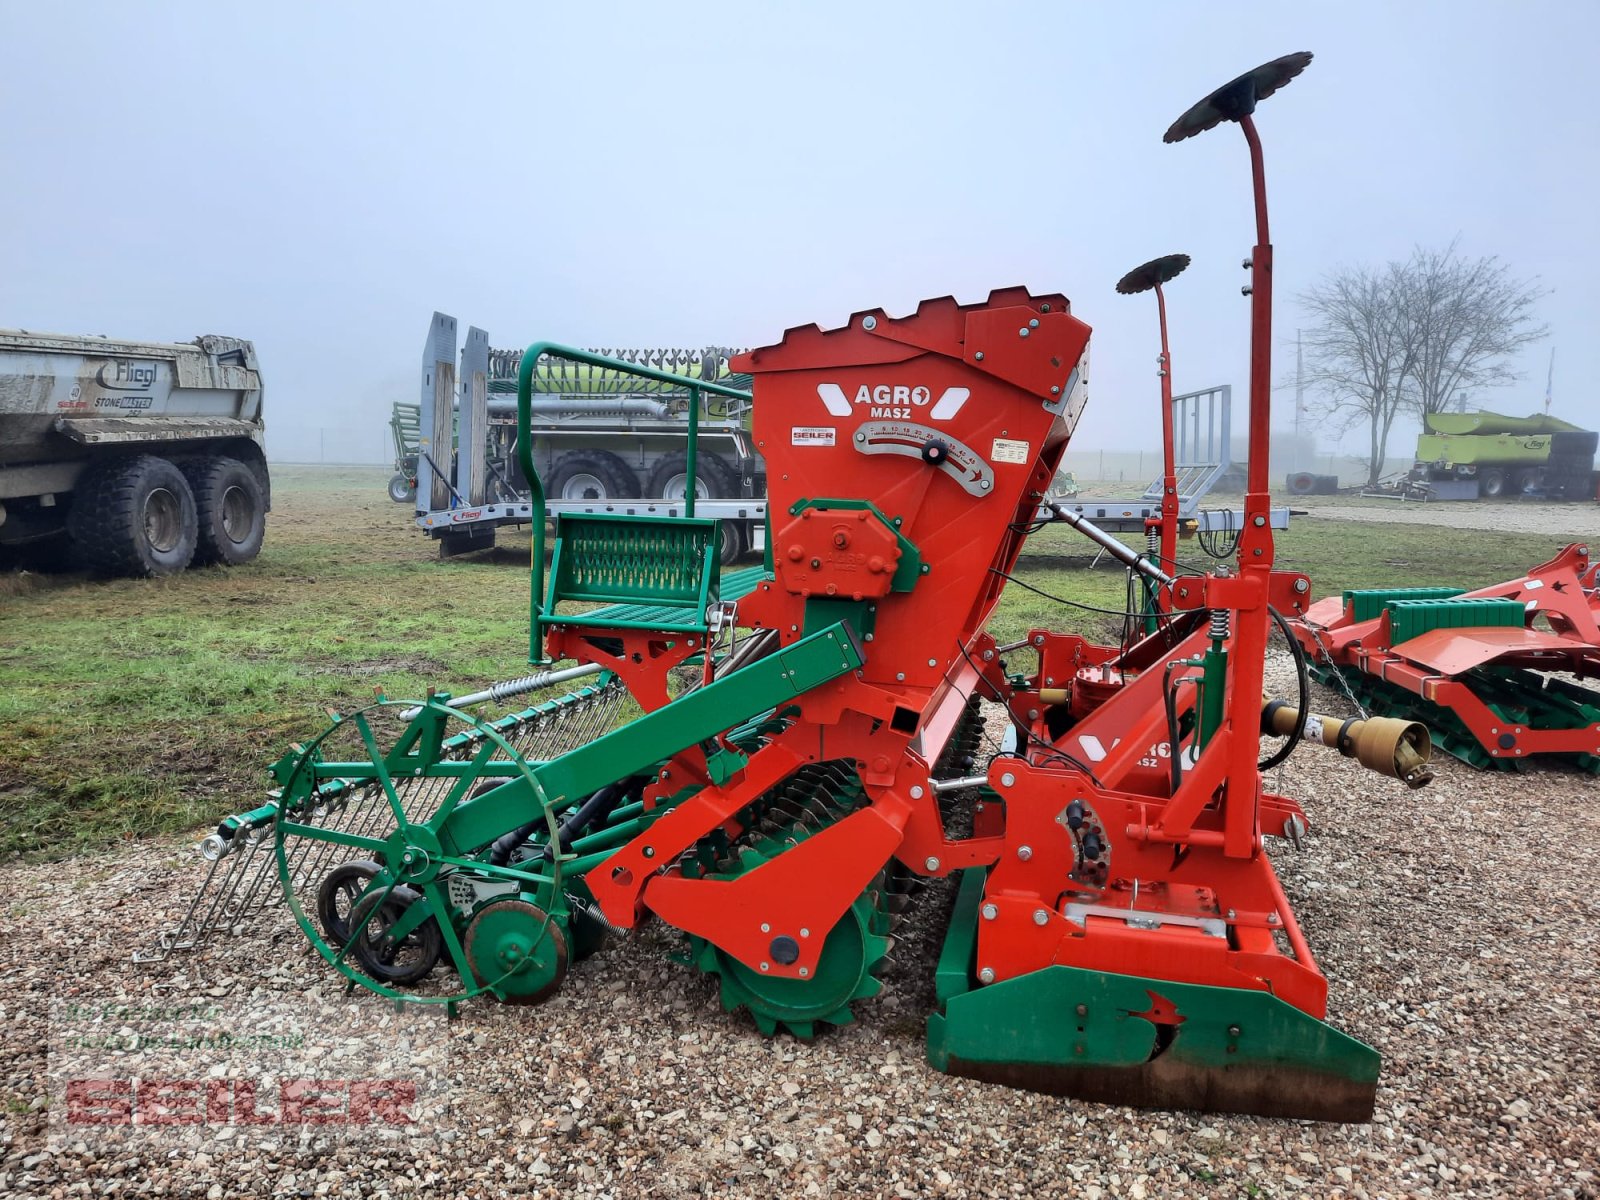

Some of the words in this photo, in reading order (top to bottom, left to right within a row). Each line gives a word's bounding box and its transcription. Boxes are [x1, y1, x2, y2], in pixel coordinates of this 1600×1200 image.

[113, 359, 157, 387] Fliegl
[854, 384, 930, 406] AGRO
[870, 407, 911, 419] MASZ
